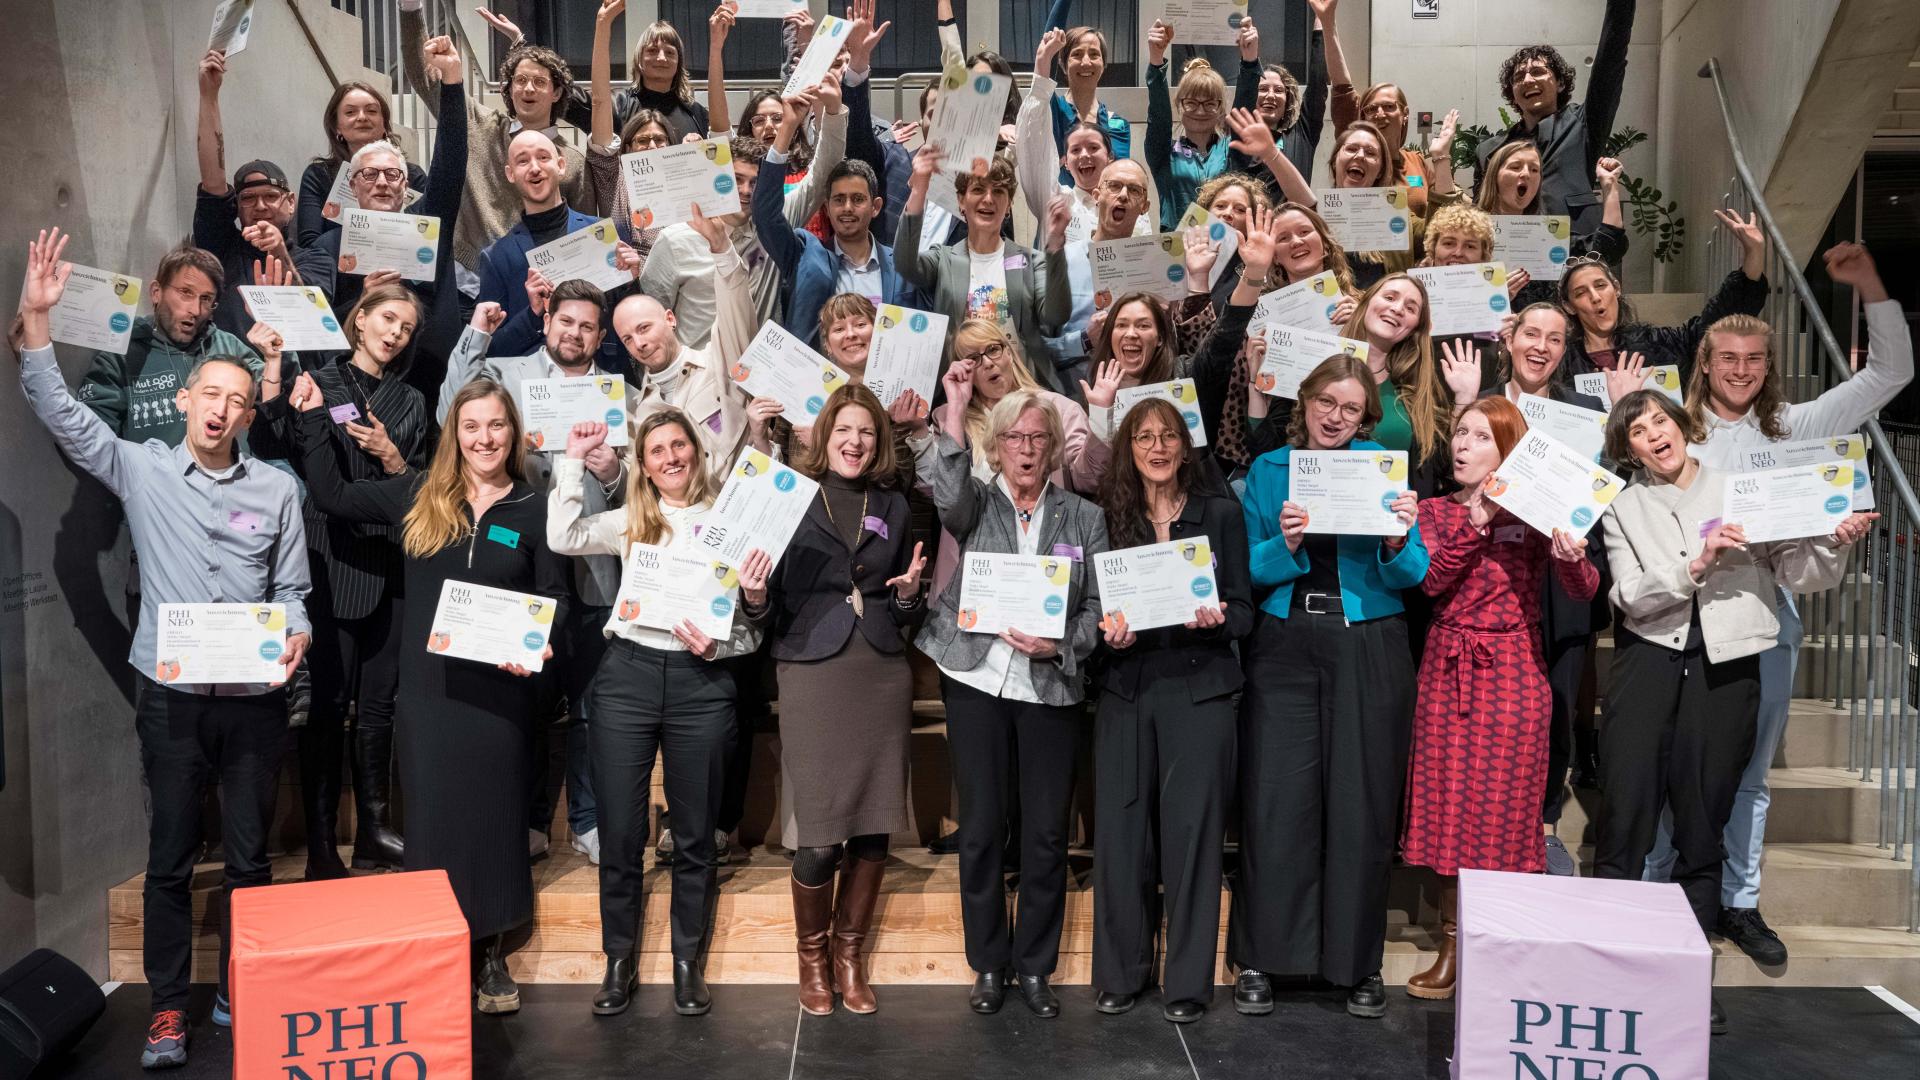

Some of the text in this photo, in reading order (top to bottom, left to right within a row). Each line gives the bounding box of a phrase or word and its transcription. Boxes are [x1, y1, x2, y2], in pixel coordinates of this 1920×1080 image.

[631, 158, 651, 169] PHI
[632, 166, 654, 177] NEO
[350, 214, 369, 223] PHI
[350, 221, 370, 230] NEO
[534, 250, 551, 262] PHI
[1096, 246, 1114, 255] PHI
[536, 255, 555, 268] NEO
[1097, 254, 1117, 263] NEO
[768, 328, 785, 343] PHI
[1272, 329, 1292, 340] PHI
[763, 335, 783, 352] NEO
[1270, 337, 1293, 348] NEO
[529, 385, 548, 393] PHI
[1583, 379, 1602, 388] PHI
[1584, 386, 1605, 394] NEO
[530, 393, 552, 401] NEO
[1526, 400, 1546, 412] PHI
[1524, 408, 1546, 420] NEO
[1529, 436, 1550, 451] PHI
[1527, 443, 1547, 460] NEO
[1750, 451, 1773, 461] PHI
[1298, 457, 1319, 466] PHI
[1752, 459, 1776, 469] NEO
[1297, 466, 1321, 475] NEO
[703, 526, 719, 546] PHI
[711, 528, 728, 550] NEO
[638, 550, 658, 561] PHI
[637, 558, 660, 570] NEO
[972, 559, 991, 568] PHI
[1103, 557, 1123, 568] PHI
[970, 567, 993, 576] NEO
[1104, 565, 1128, 576] NEO
[450, 587, 471, 598] PHI
[449, 595, 472, 606] NEO
[168, 610, 190, 618] PHI
[168, 618, 194, 627] NEO
[281, 1001, 408, 1058] PHI
[1509, 999, 1643, 1056] PHI
